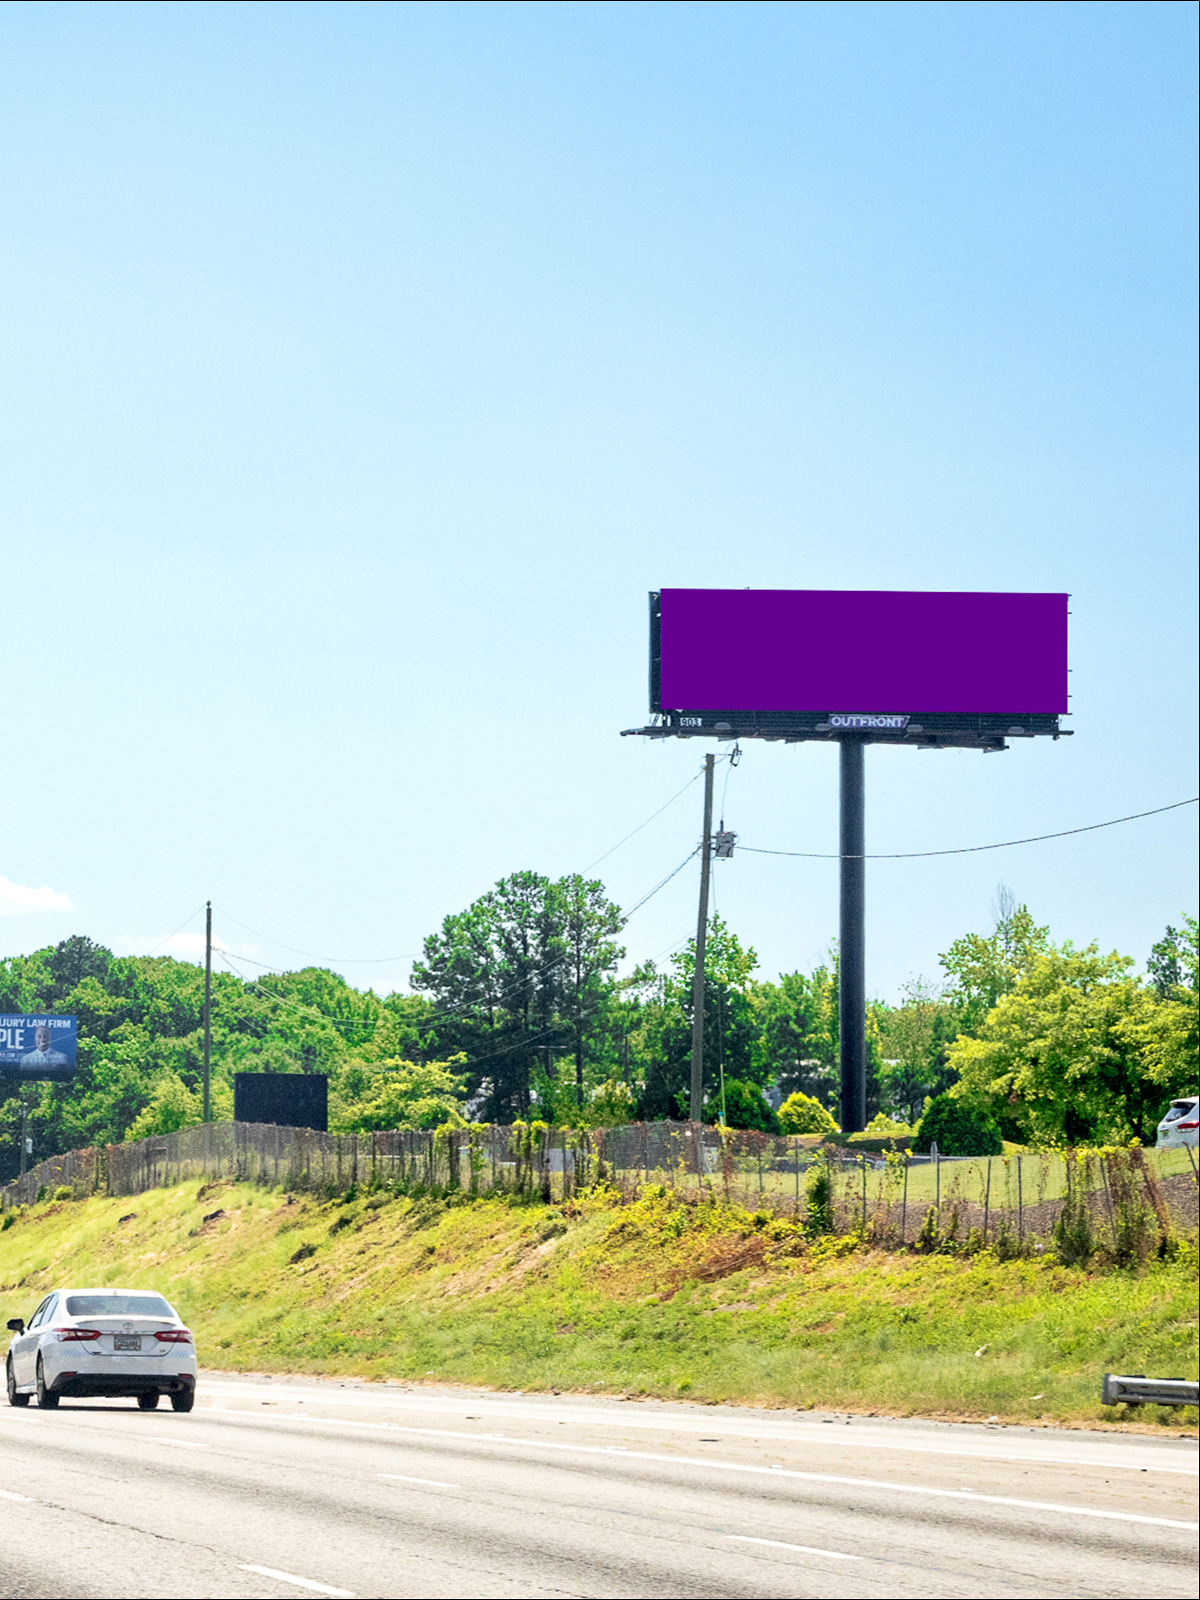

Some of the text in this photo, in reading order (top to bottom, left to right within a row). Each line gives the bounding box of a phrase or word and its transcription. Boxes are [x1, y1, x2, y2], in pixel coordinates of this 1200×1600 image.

[681, 718, 699, 727] 903
[831, 716, 905, 727] OUTFRONT
[27, 1018, 47, 1028] LAW
[48, 1019, 71, 1028] FIRM
